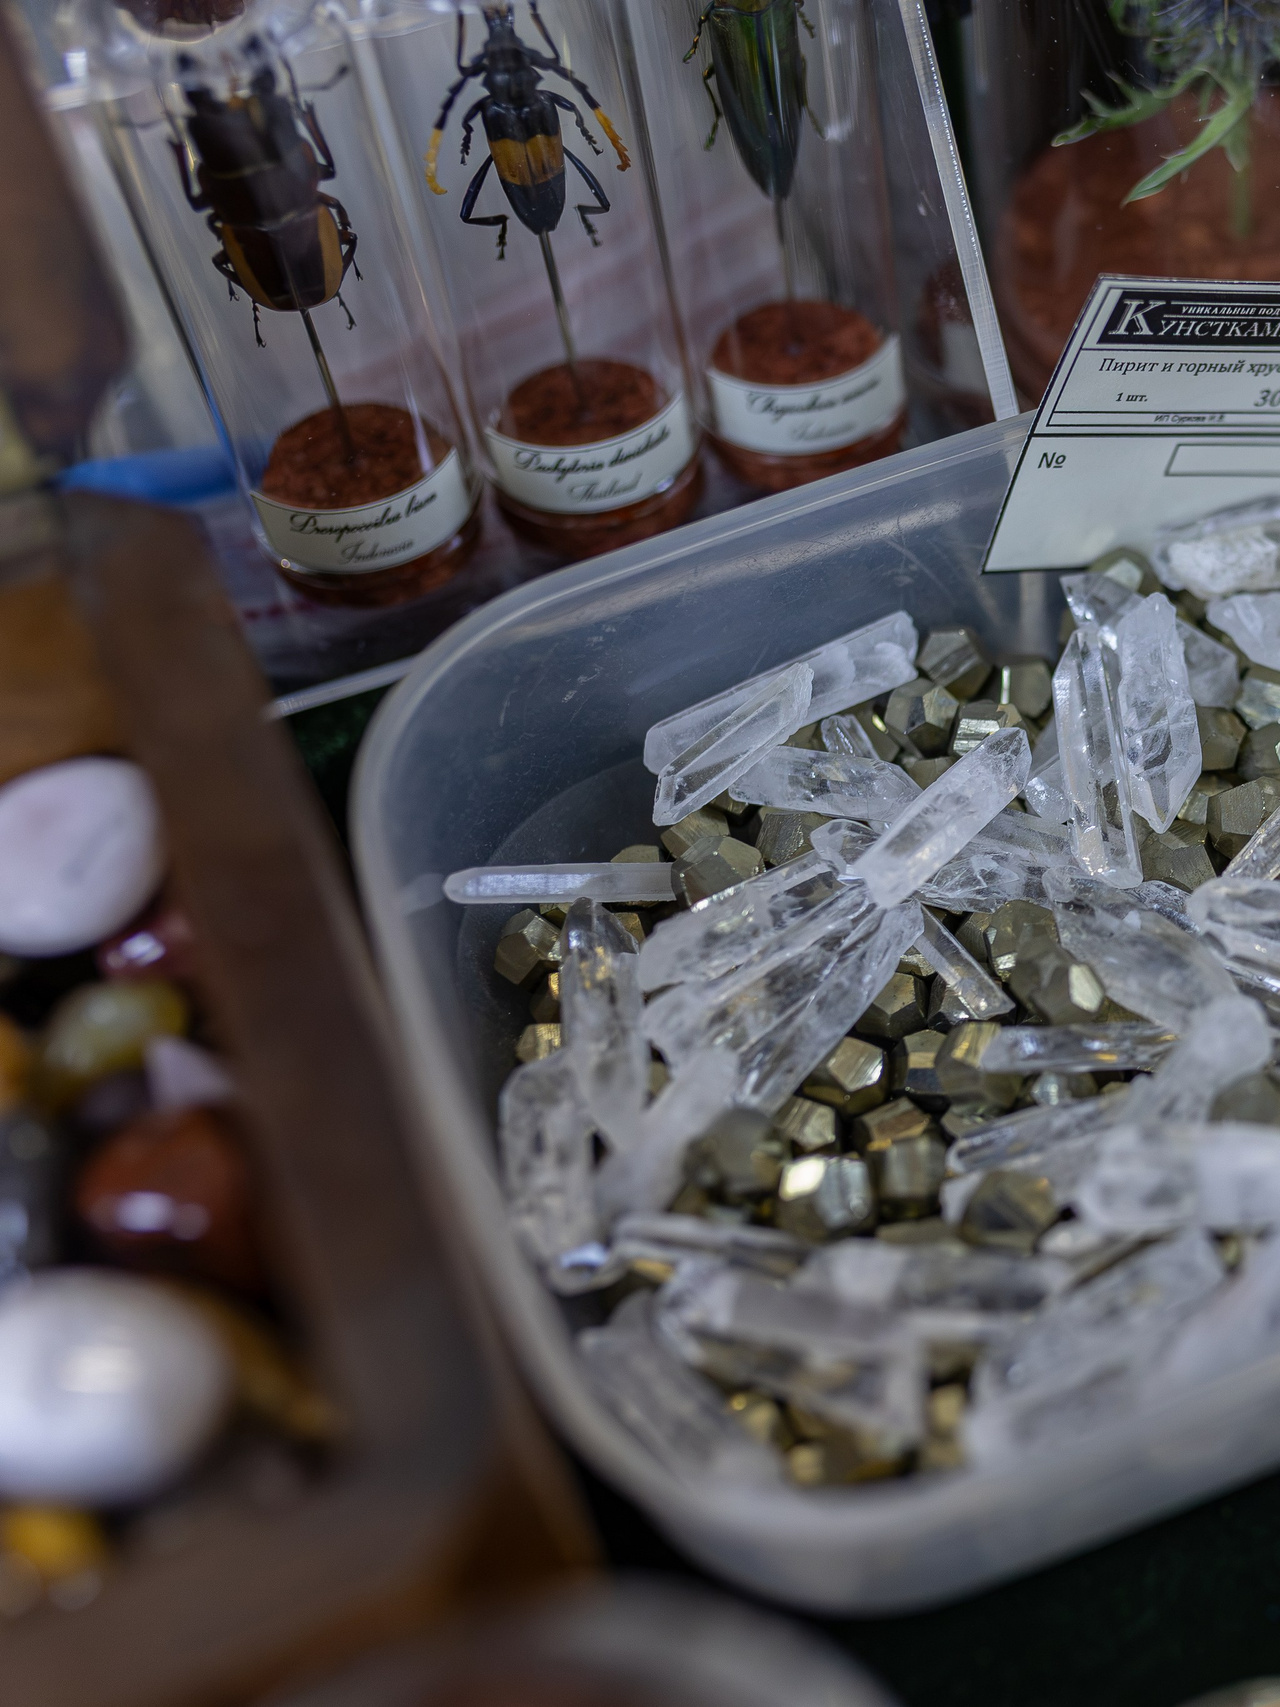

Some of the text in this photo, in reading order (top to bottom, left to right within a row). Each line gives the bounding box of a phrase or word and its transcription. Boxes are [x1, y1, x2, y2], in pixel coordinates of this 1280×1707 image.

[1181, 305, 1256, 315] УНИКАЛЬНЫЕ
[1099, 358, 1159, 375] Пирит
[1161, 362, 1173, 372] и
[1177, 360, 1246, 376] горный
[1115, 393, 1124, 402] 1
[1126, 393, 1148, 402] шт.
[1154, 414, 1170, 422] ИП
[1037, 452, 1067, 469] №
